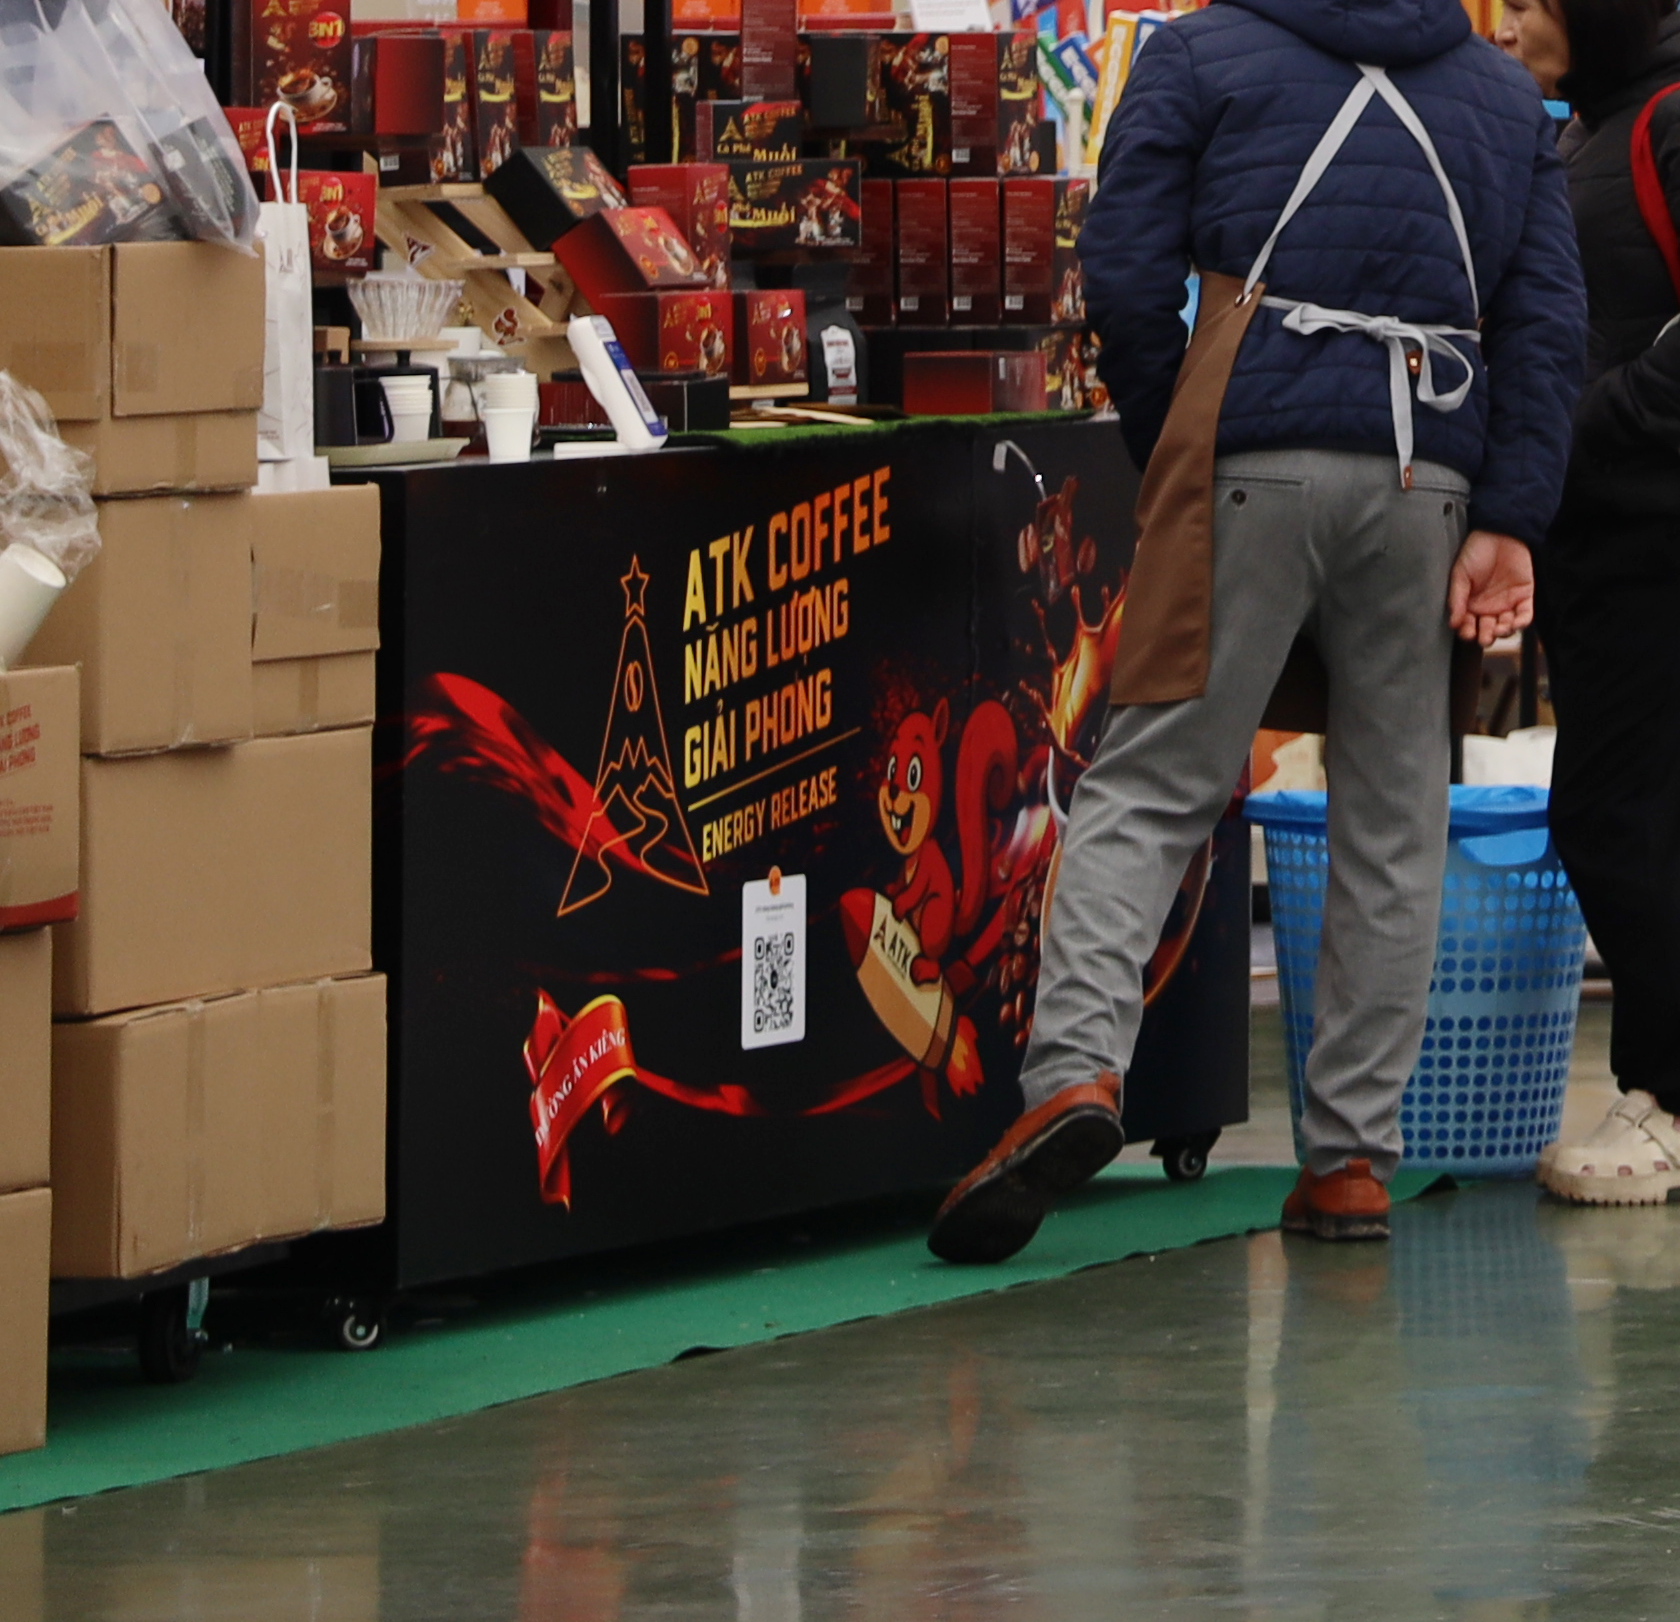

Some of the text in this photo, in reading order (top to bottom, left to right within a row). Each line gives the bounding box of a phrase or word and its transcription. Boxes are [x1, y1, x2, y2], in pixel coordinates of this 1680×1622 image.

[683, 465, 891, 633] ATK COFFEE
[684, 578, 849, 705] NĂNG LƯỢNG
[684, 698, 737, 789] GIẢI
[702, 765, 838, 864] ENERGY RELEASE
[889, 929, 912, 975] ATK
[589, 1028, 626, 1066] KIÊNG
